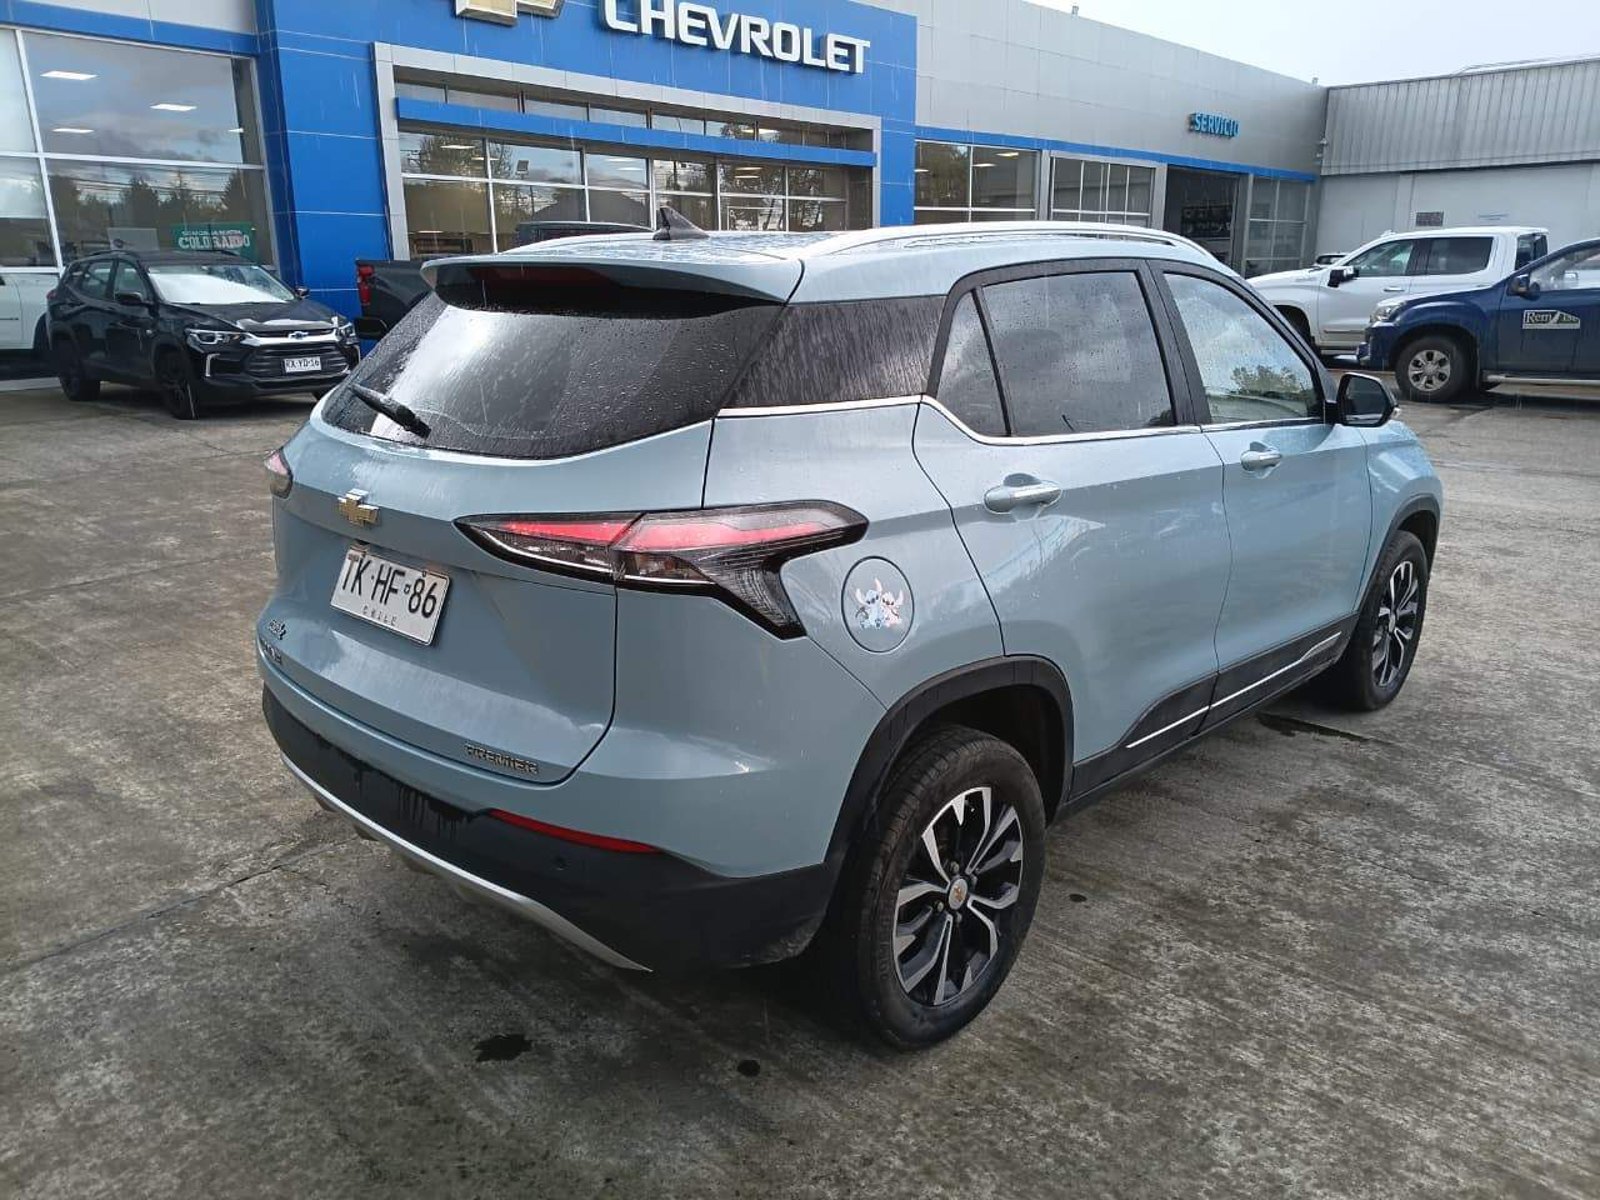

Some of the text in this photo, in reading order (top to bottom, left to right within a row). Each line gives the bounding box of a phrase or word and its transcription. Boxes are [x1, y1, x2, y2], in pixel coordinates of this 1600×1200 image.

[604, 0, 871, 74] CHEVROLET
[1193, 112, 1241, 137] SERVICIO
[464, 743, 538, 774] PREMIER
